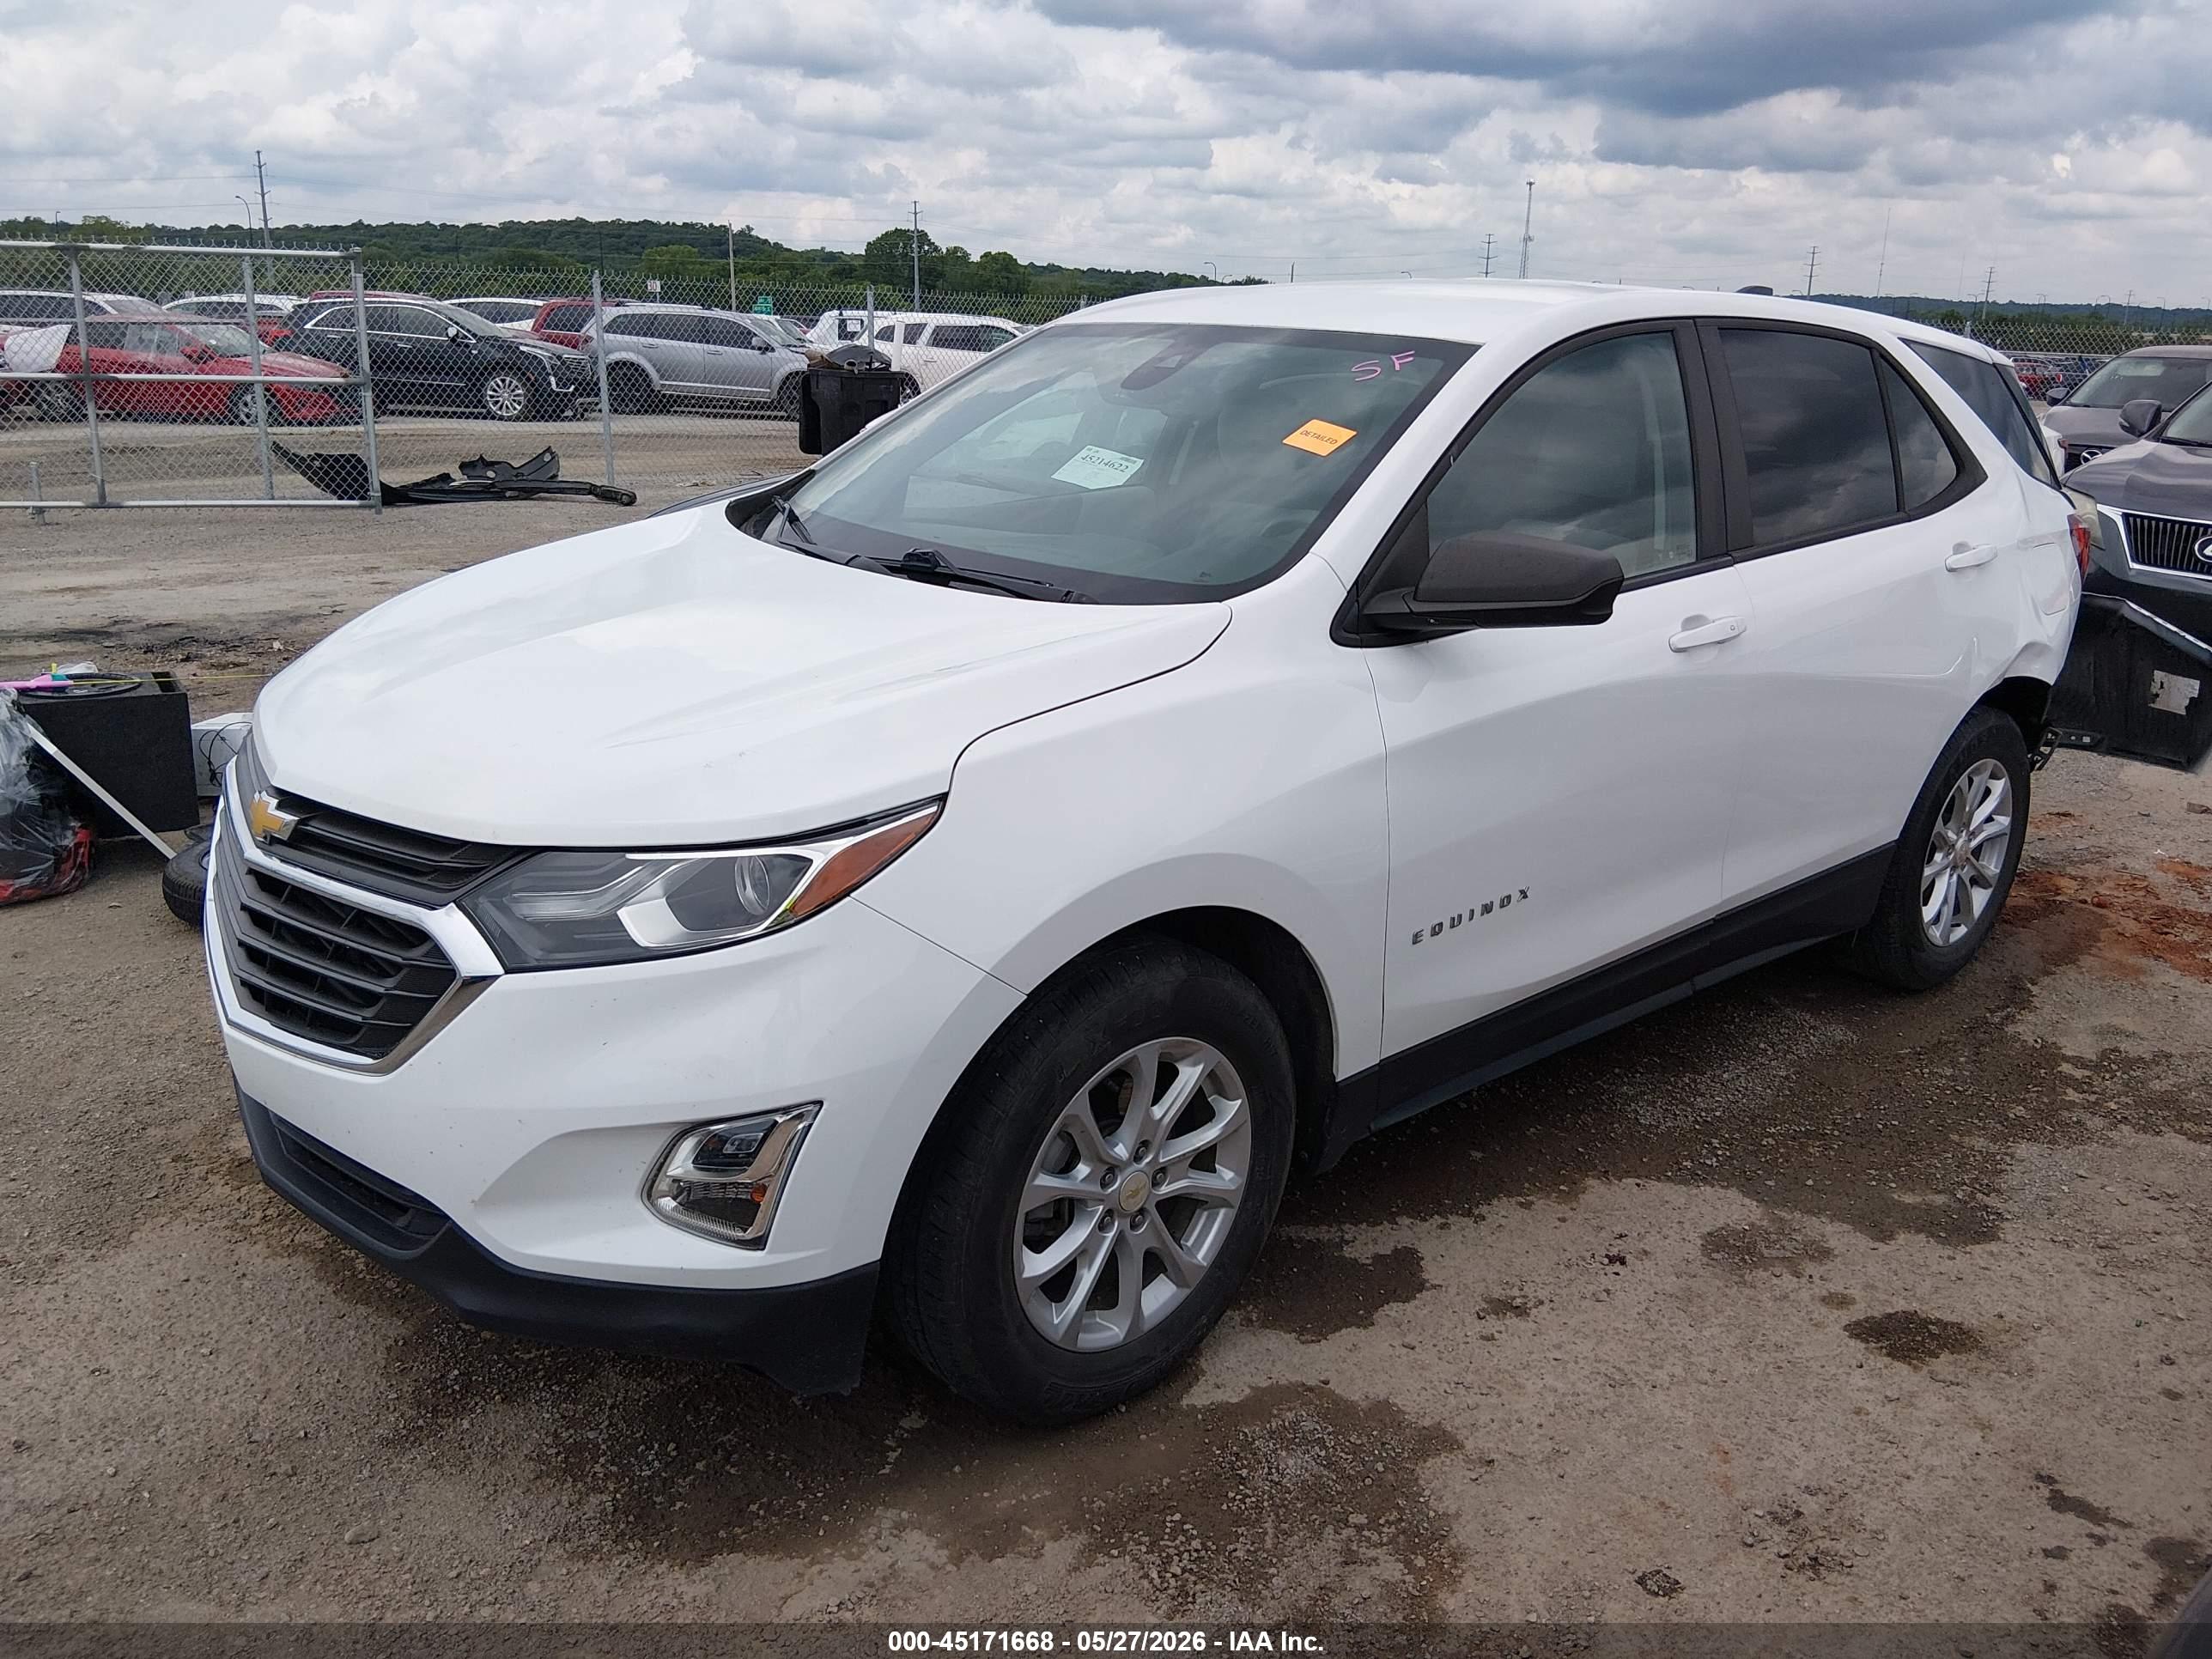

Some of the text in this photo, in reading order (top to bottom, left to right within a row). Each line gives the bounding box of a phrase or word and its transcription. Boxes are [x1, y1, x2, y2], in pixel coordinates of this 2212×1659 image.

[1300, 429, 1338, 445] DETAILED
[1081, 454, 1129, 473] 45214622
[1412, 886, 1529, 945] EQUINOX
